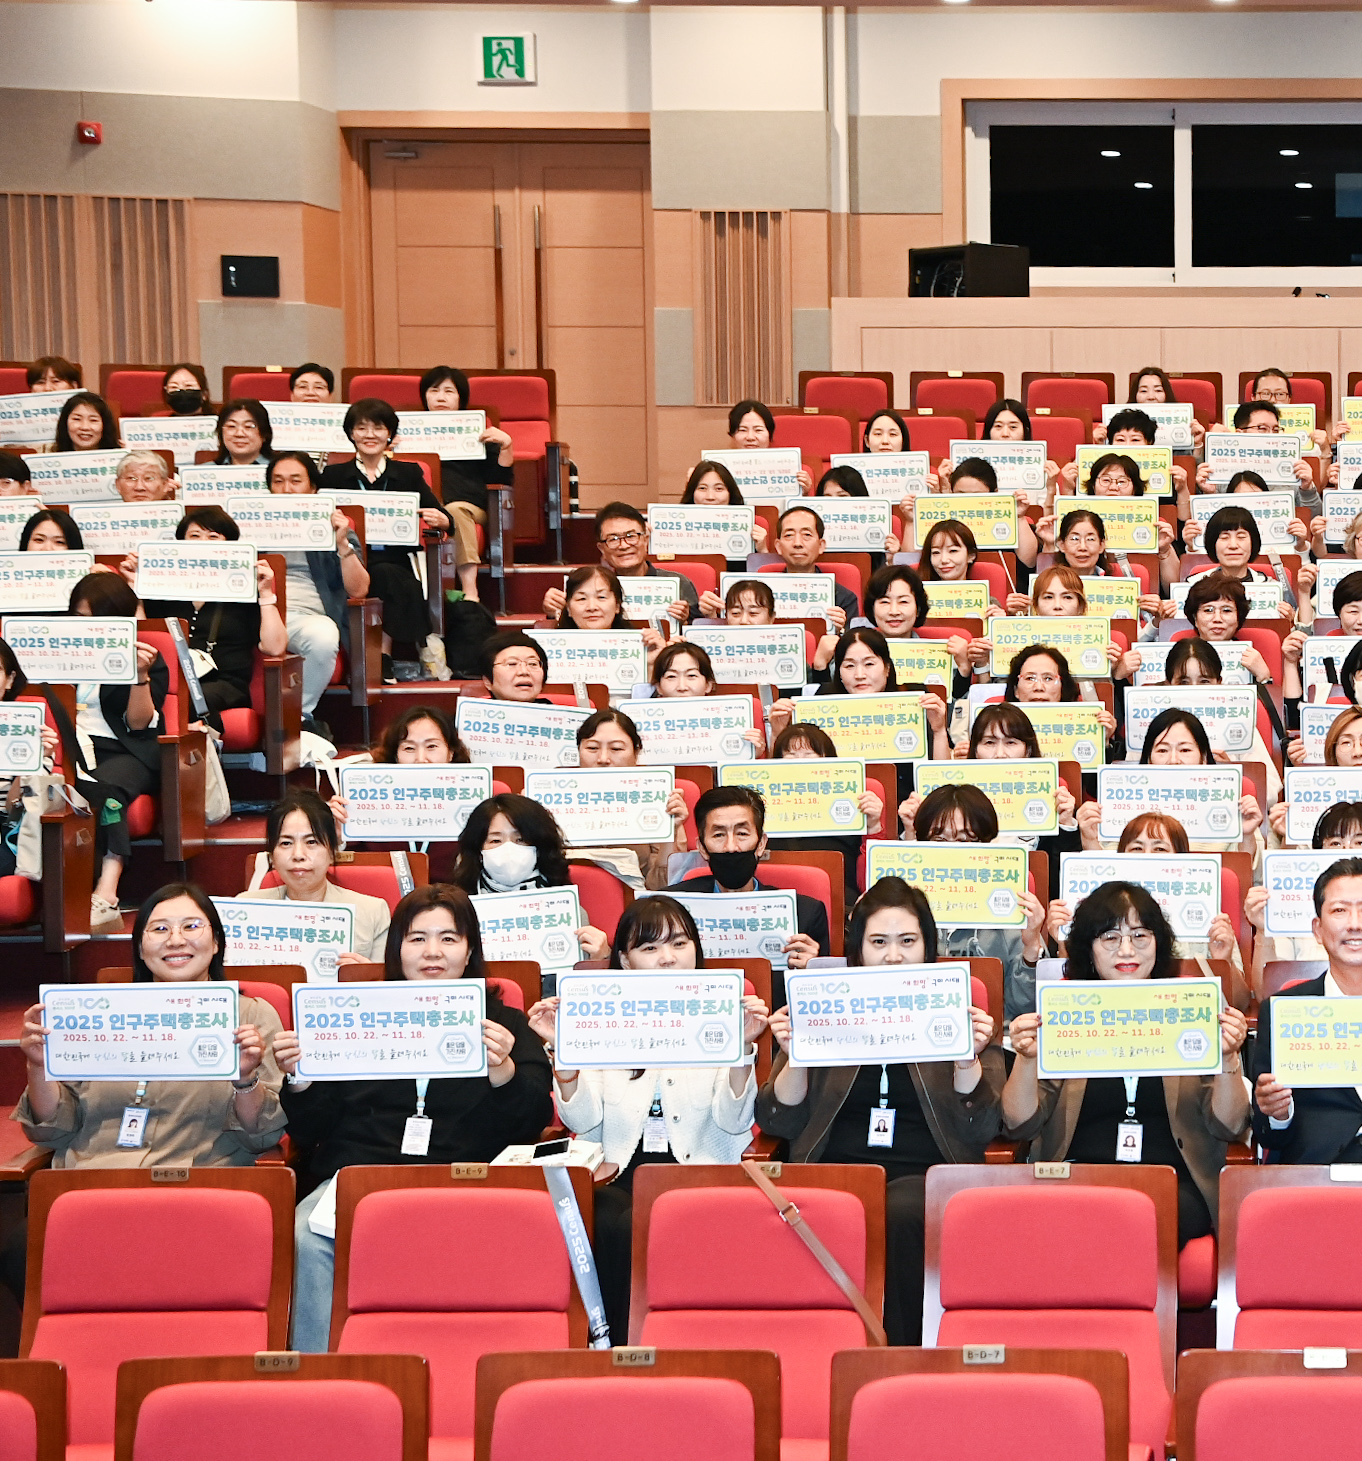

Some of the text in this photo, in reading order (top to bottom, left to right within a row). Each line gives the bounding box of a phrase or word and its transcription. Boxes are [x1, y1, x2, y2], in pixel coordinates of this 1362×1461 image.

[1239, 447, 1300, 458] 인구주택총조사
[232, 511, 260, 520] 2025
[823, 514, 886, 523] 인구주택총조사
[920, 510, 1011, 521] 2025 인구주택총조사
[78, 519, 107, 530] 2025
[655, 521, 748, 532] 2025 인구주택총조사
[143, 559, 249, 570] 2025 인구주택총조사
[14, 568, 89, 581] 인구주택총조사
[10, 638, 128, 649] 2025 인구주택총조사
[997, 635, 1027, 644] 2025
[566, 649, 640, 659] 인구주택총조사
[725, 644, 798, 656] 인구주택총조사
[183, 658, 194, 680] 2025
[664, 717, 745, 731] 인구주택총조사
[838, 713, 919, 727] 인구주택총조사
[464, 721, 499, 734] 2025
[349, 787, 487, 800] 2025 인구주택총조사
[769, 781, 857, 796] 인구주택총조사
[577, 791, 666, 804] 인구주택총조사
[1106, 788, 1235, 802] 2025 인구주택총조사
[1294, 791, 1331, 802] 2025
[394, 851, 407, 876] Census
[922, 868, 1019, 883] 인구주택총조사
[247, 926, 345, 944] 인구주택총조사
[567, 999, 734, 1016] 2025 인구주택총조사
[797, 993, 961, 1015] 2025 인구주택총조사
[53, 1013, 228, 1030] 2025 인구주택총조사
[305, 1010, 475, 1028] 2025 인구주택총조사
[1048, 1007, 1212, 1025] 2025 인구주택총조사
[1057, 1029, 1082, 1038] 2025.
[1087, 1029, 1100, 1038] 10.
[1104, 1029, 1118, 1038] 22.
[1132, 1028, 1145, 1037] 11.
[1150, 1028, 1163, 1037] 18.
[1280, 1023, 1328, 1038] 2025
[63, 1034, 90, 1042] 2025.
[95, 1034, 109, 1042] 10.
[113, 1034, 128, 1042] 22.
[143, 1033, 157, 1041] 11.
[162, 1033, 176, 1041] 18.
[140, 1051, 180, 1062] 들려주세요
[154, 1170, 186, 1178] B-E-10
[559, 1197, 590, 1274] 2025 Census
[618, 1354, 650, 1362] B-D-8
[968, 1351, 1000, 1359] B-D-7
[260, 1358, 293, 1366] B-D-9
